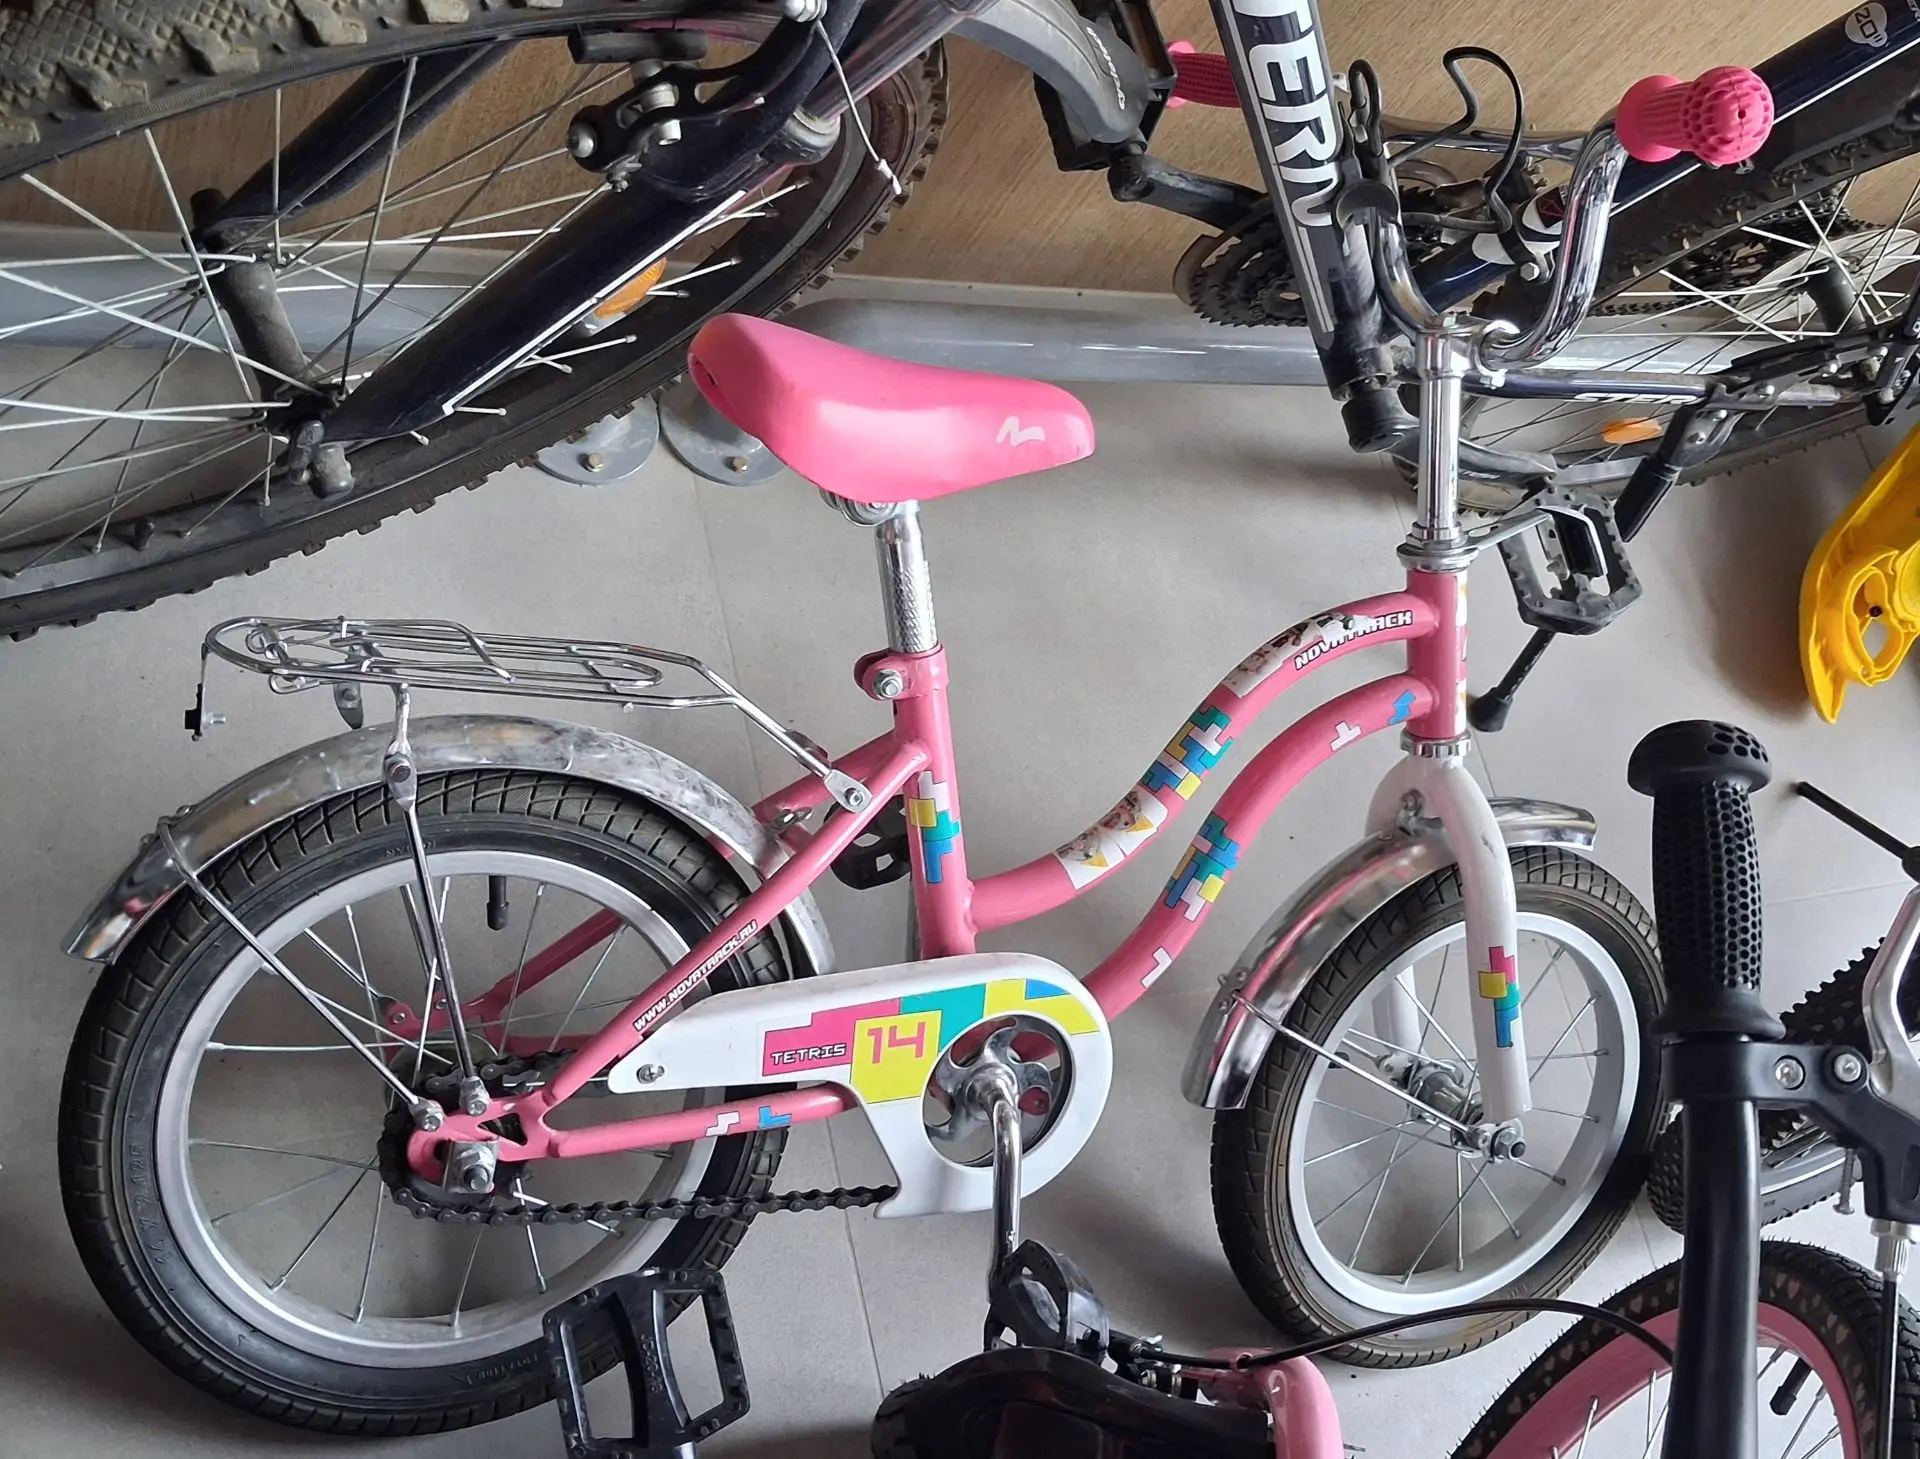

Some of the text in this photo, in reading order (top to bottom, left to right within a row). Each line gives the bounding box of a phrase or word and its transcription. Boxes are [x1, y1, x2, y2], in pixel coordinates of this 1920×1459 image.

[632, 919, 758, 1032] WWW.NOVATRACK.RU
[771, 1022, 925, 1066] TETRIS 14
